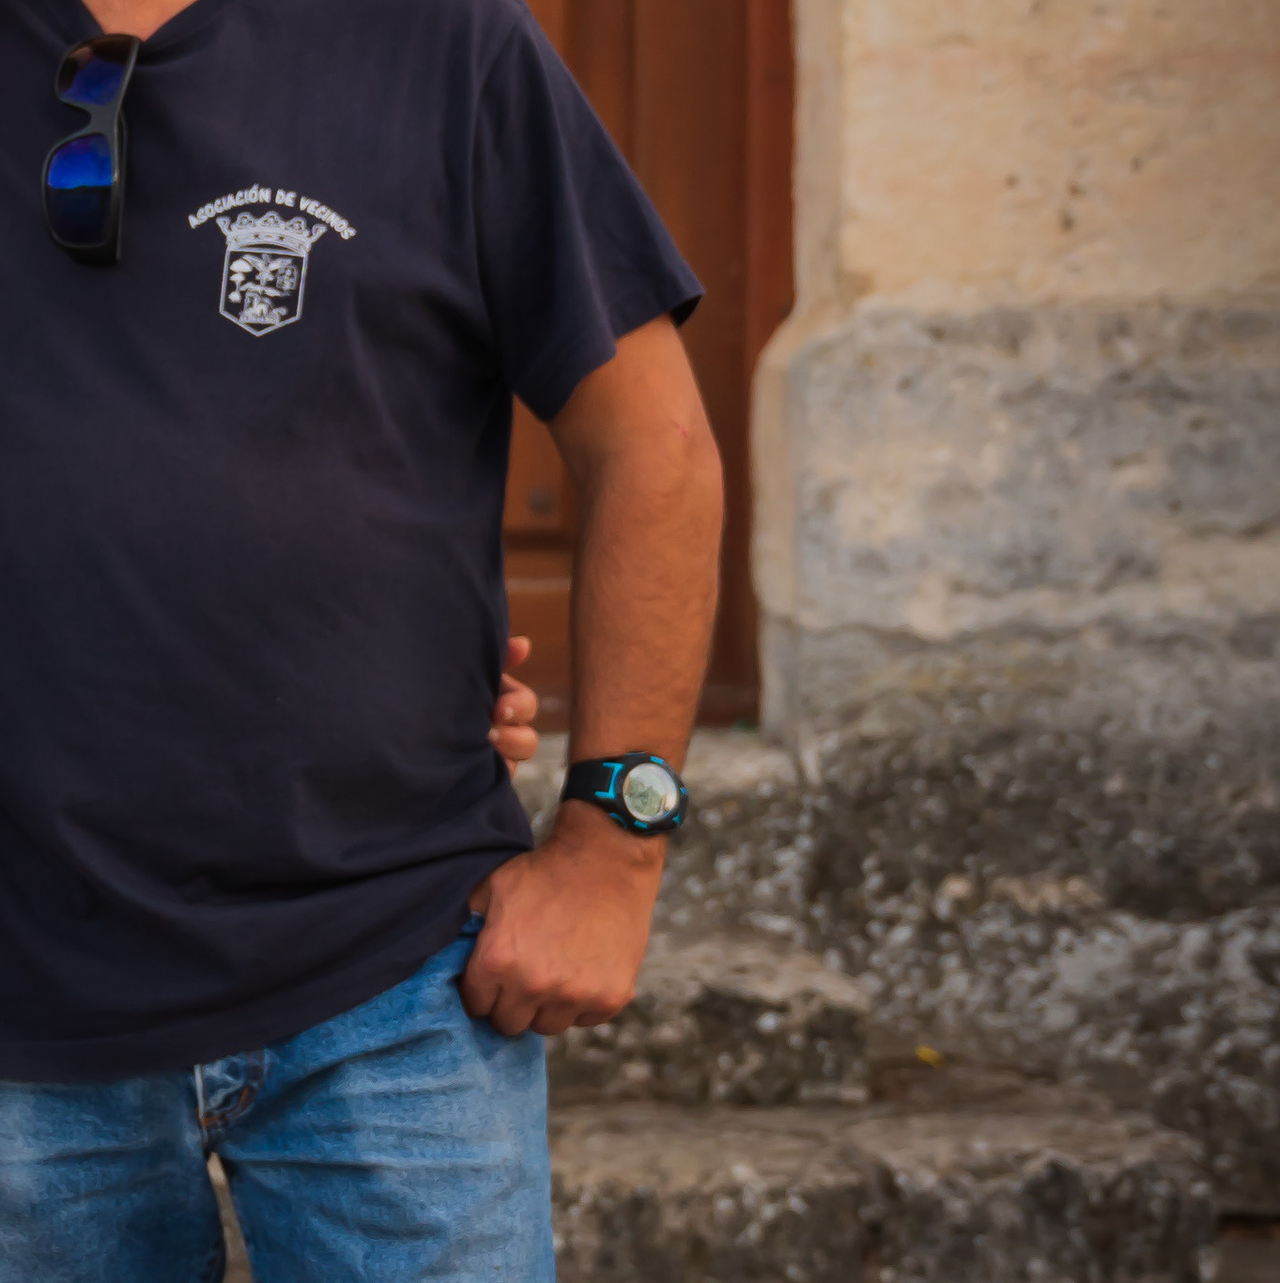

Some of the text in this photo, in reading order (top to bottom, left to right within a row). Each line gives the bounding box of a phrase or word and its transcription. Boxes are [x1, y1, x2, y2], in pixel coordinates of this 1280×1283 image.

[188, 184, 357, 240] ASOCIACIÓN DE VECINOS
